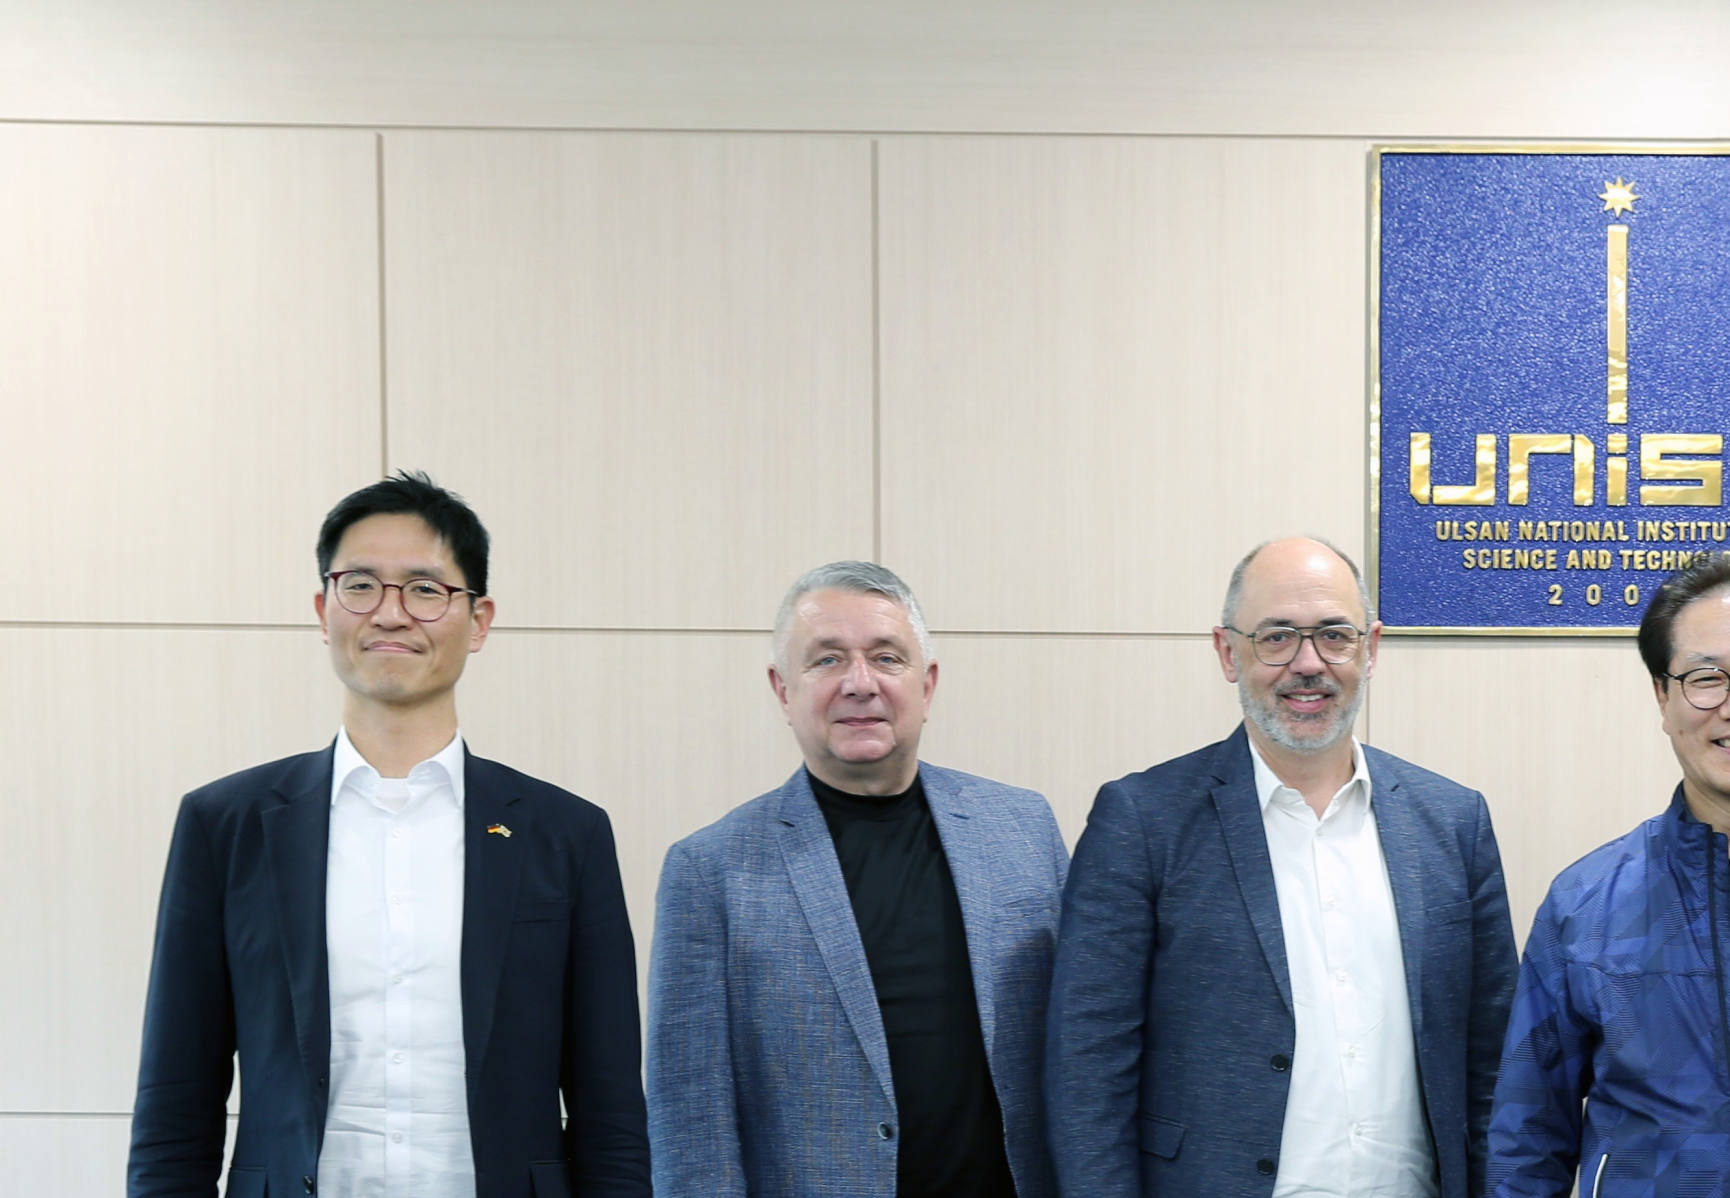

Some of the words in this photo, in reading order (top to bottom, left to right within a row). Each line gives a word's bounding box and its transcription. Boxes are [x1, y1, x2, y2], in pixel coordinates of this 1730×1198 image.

[1436, 521, 1510, 541] ULSAN
[1519, 521, 1630, 541] NATIONAL
[1463, 549, 1558, 570] SCIENCE
[1566, 550, 1612, 570] AND
